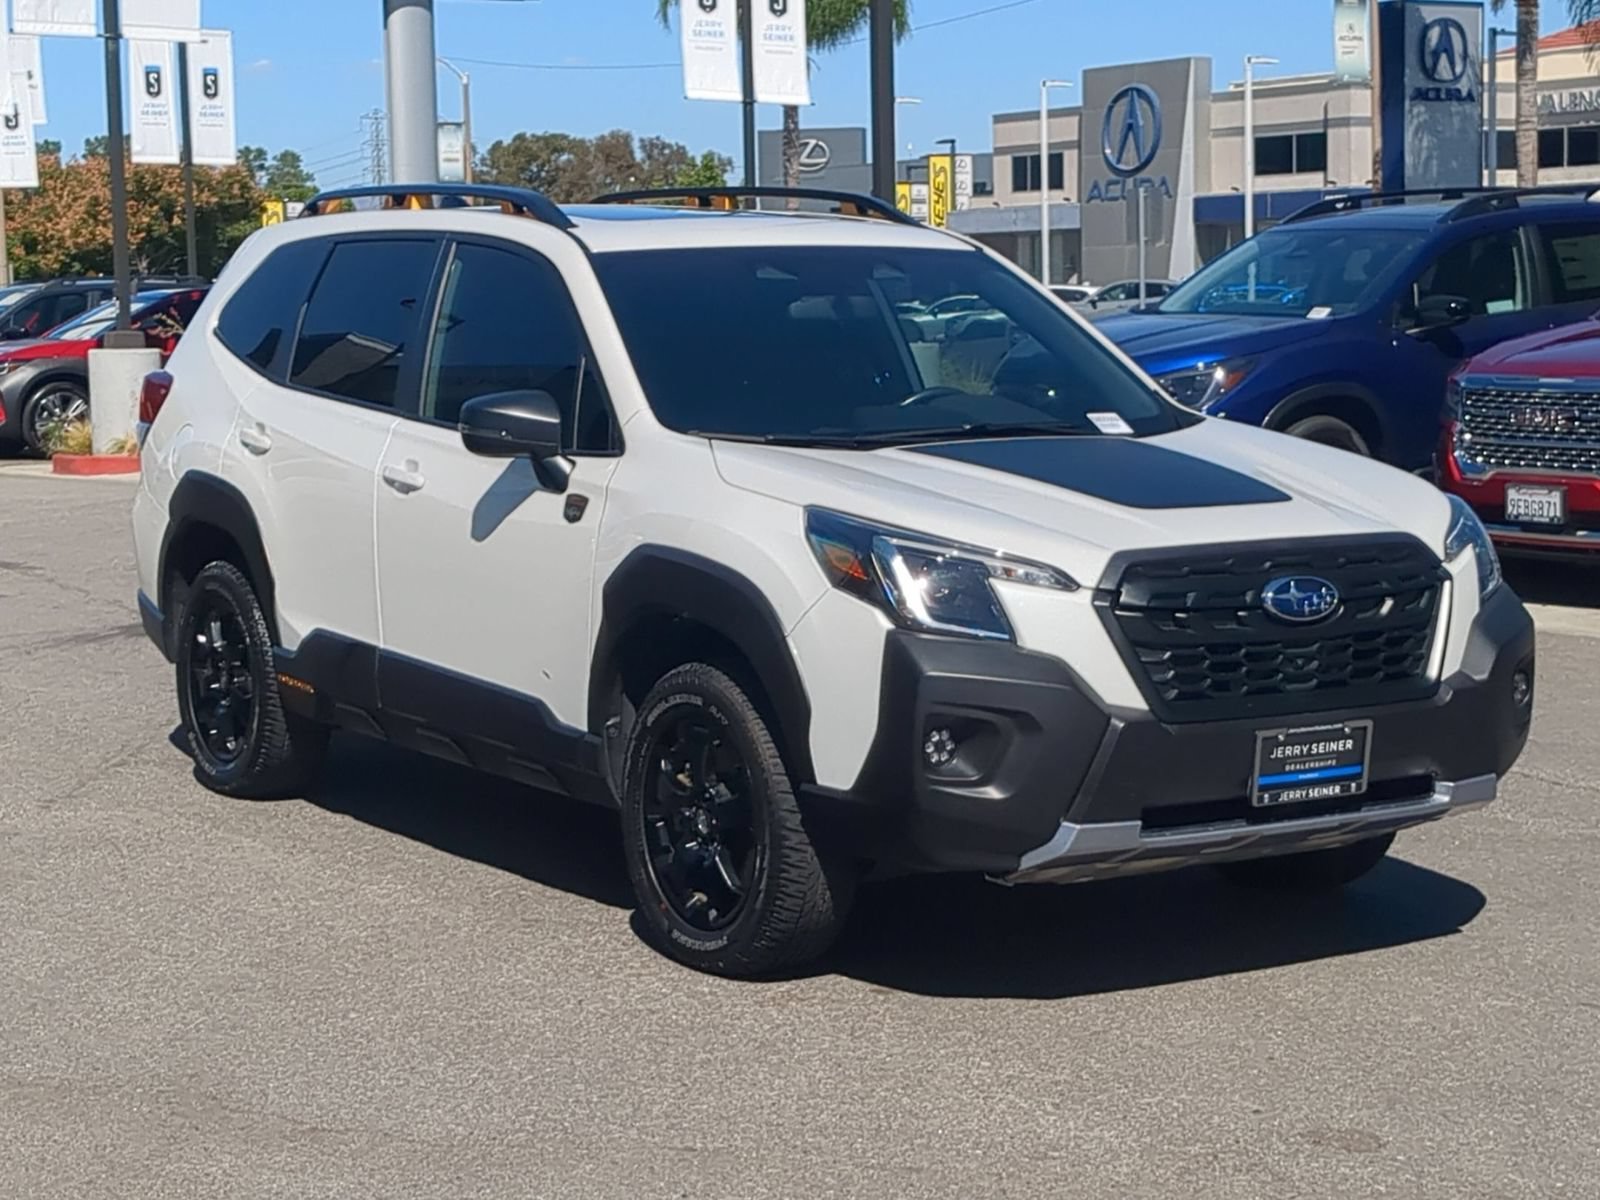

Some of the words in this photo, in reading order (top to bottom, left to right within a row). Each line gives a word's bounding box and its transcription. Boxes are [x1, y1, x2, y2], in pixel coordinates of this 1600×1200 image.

[692, 29, 725, 38] SEINER
[764, 23, 793, 33] JERRY
[763, 33, 794, 42] SEINER
[1409, 87, 1476, 102] ACURA
[1269, 743, 1310, 759] JERRY
[1310, 739, 1354, 755] SEINER
[1278, 789, 1308, 802] JERRY
[1308, 784, 1341, 798] SEINER
